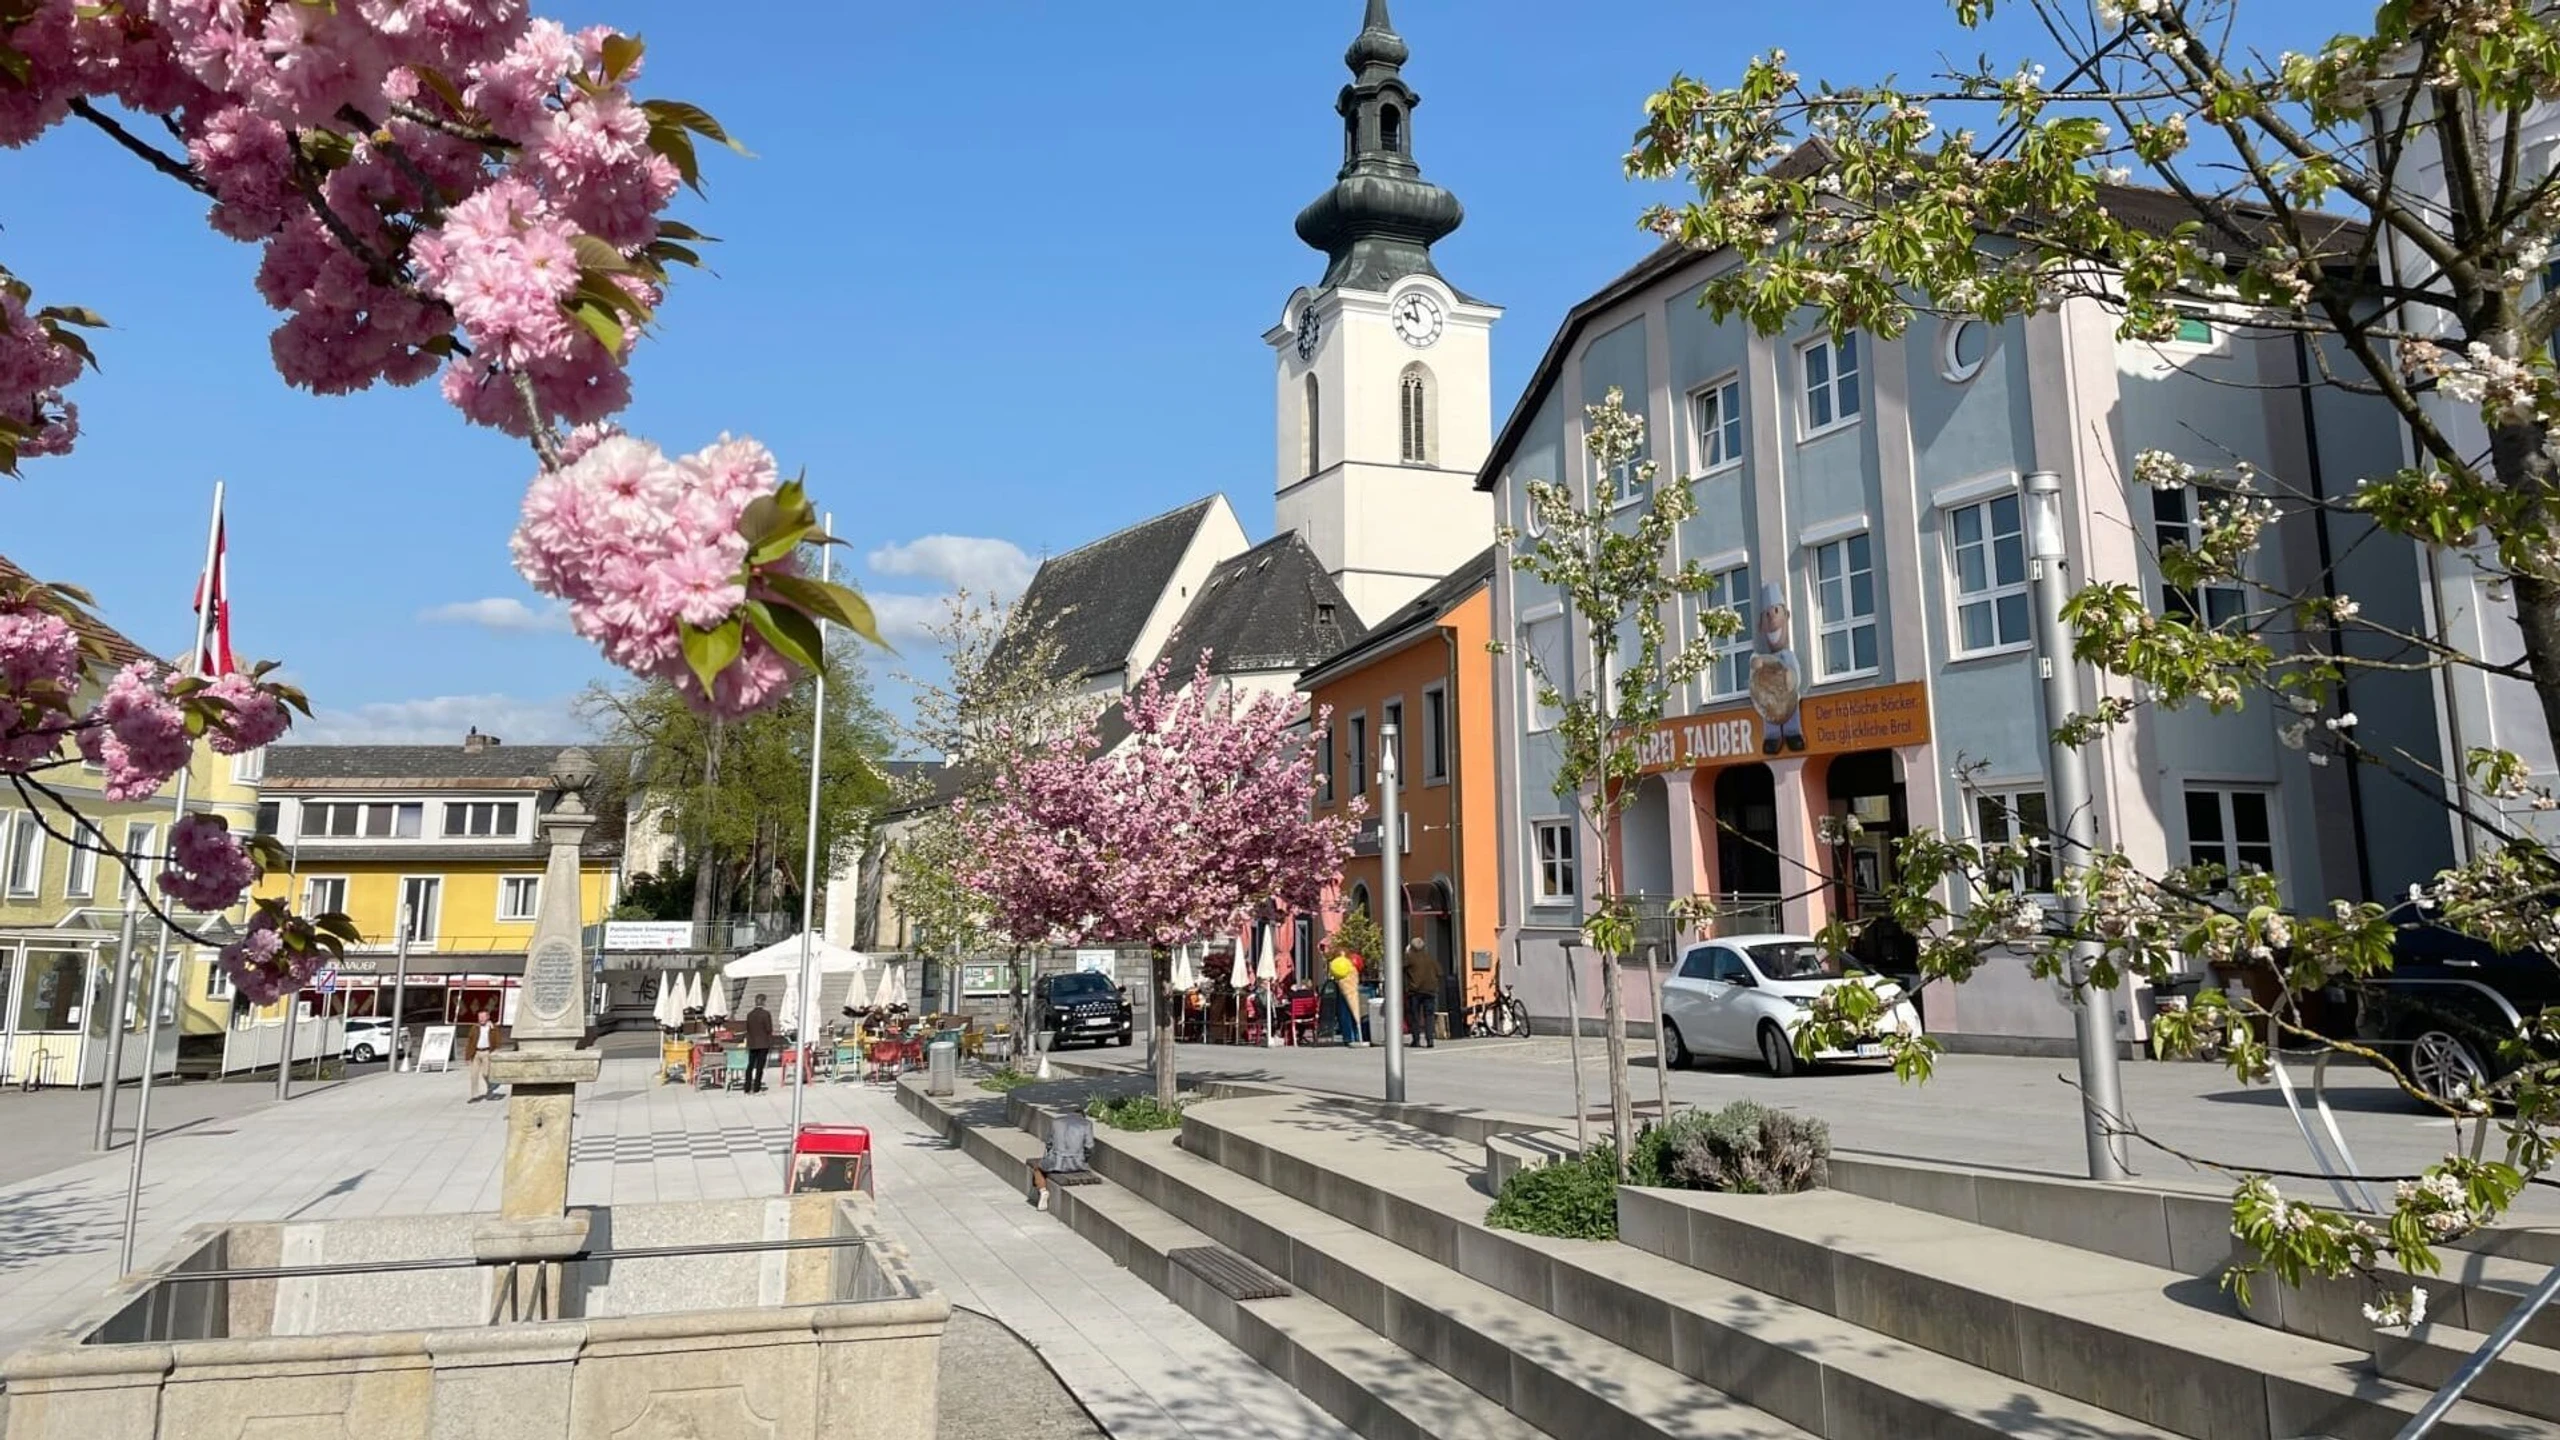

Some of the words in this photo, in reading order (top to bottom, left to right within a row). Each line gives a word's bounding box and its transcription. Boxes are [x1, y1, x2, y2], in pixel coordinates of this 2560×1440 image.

[1815, 706, 1833, 721] Der
[1684, 718, 1754, 758] TAUBER
[1817, 727, 1836, 742] Das
